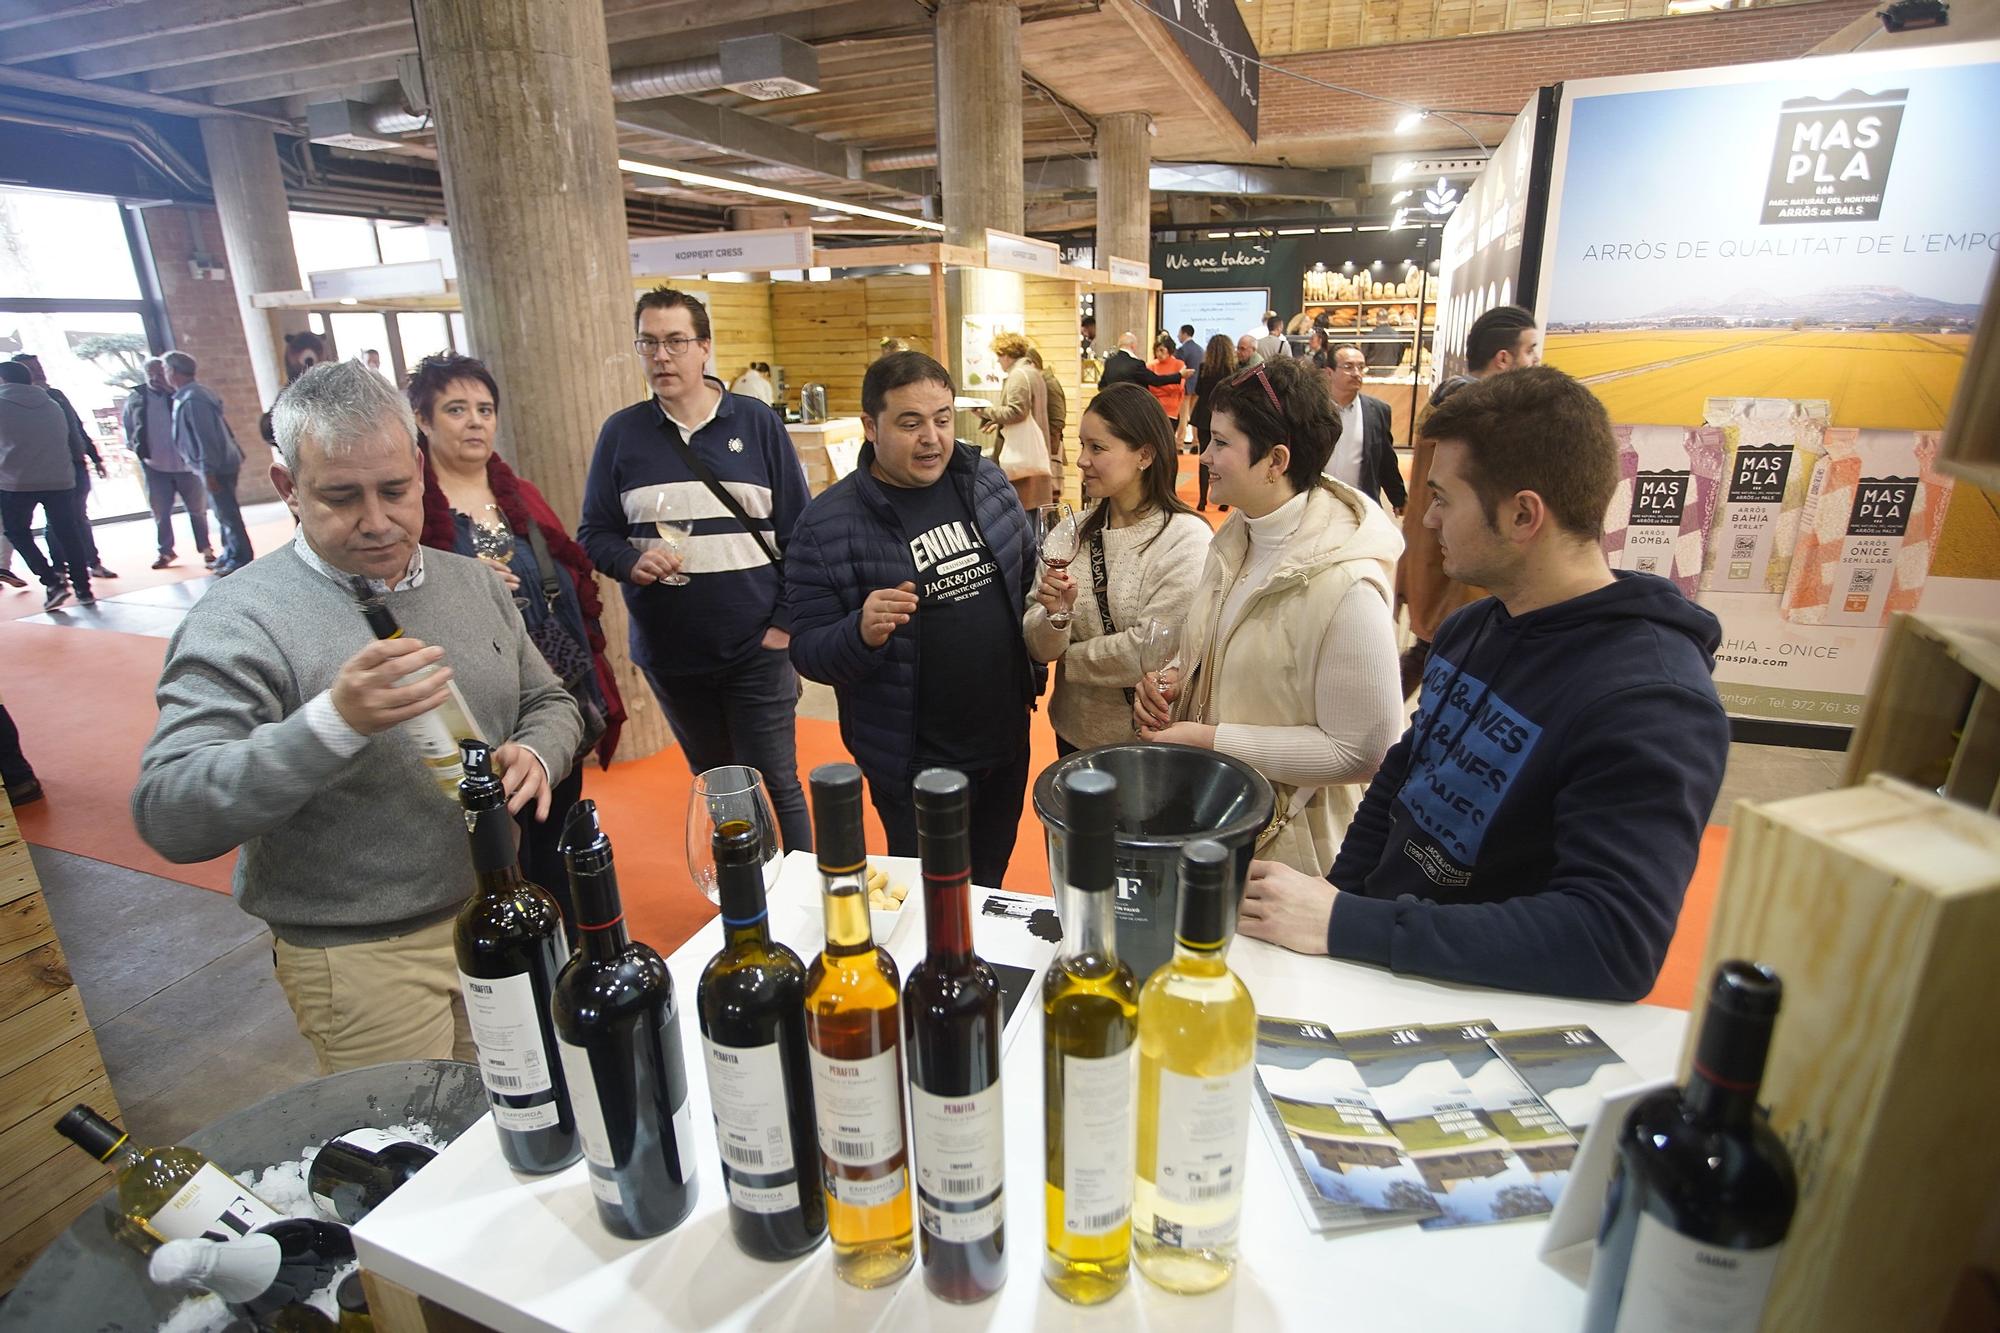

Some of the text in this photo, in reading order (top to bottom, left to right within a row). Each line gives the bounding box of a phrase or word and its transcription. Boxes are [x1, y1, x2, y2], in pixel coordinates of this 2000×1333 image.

[1791, 115, 1882, 152] MAS
[1785, 151, 1871, 184] PLA
[1778, 206, 1819, 217] ARRÒS
[1834, 206, 1864, 216] PALS
[715, 247, 743, 258] CRESS
[1582, 239, 1668, 261] ARRÒS
[1676, 240, 1710, 259] DE
[1718, 236, 1848, 258] QUALITAT
[1856, 235, 1895, 254] DE
[1166, 250, 1266, 270] We are bakers
[1742, 456, 1782, 471] MAS
[1739, 471, 1778, 485] PLA
[1641, 481, 1680, 495] MAS
[1640, 496, 1676, 509] PLA
[1863, 489, 1906, 503] MAS
[1731, 514, 1768, 522] BAHIA
[1859, 504, 1900, 518] PLA
[1631, 536, 1670, 545] BOMBA
[1850, 547, 1890, 556] ONICE
[924, 561, 998, 598] JACK&JONES
[937, 577, 992, 600] AUTHENTIC QUALITY
[1778, 643, 1840, 660] ONICE
[1768, 697, 1785, 708] Tel.
[1791, 699, 1815, 711] 972
[1819, 702, 1840, 713] 761
